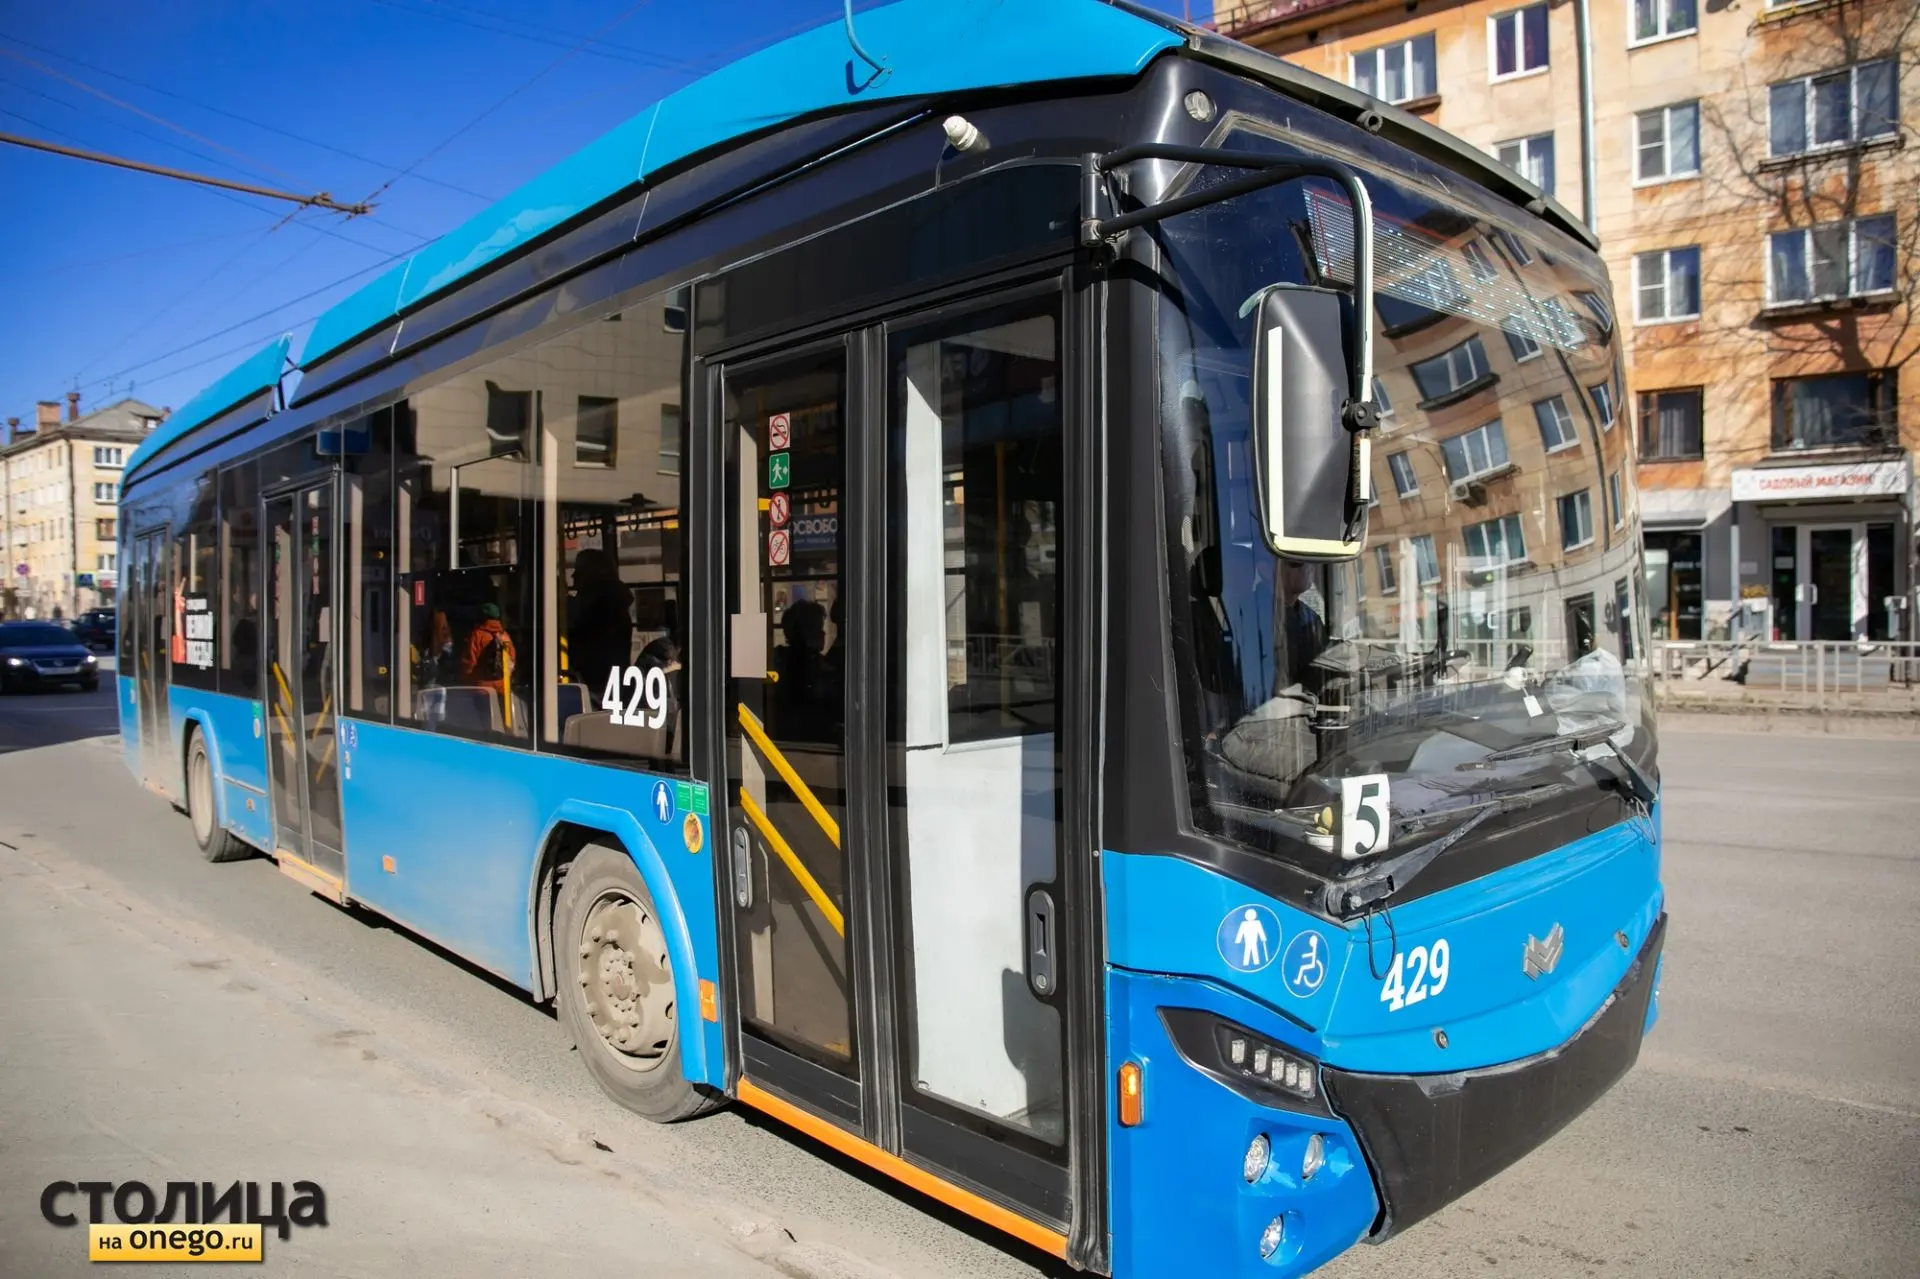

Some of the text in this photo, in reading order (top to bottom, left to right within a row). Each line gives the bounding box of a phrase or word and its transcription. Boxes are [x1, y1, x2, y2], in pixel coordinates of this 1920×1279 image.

[602, 665, 668, 729] 429
[1355, 783, 1380, 855] 5
[1380, 938, 1450, 1012] 429
